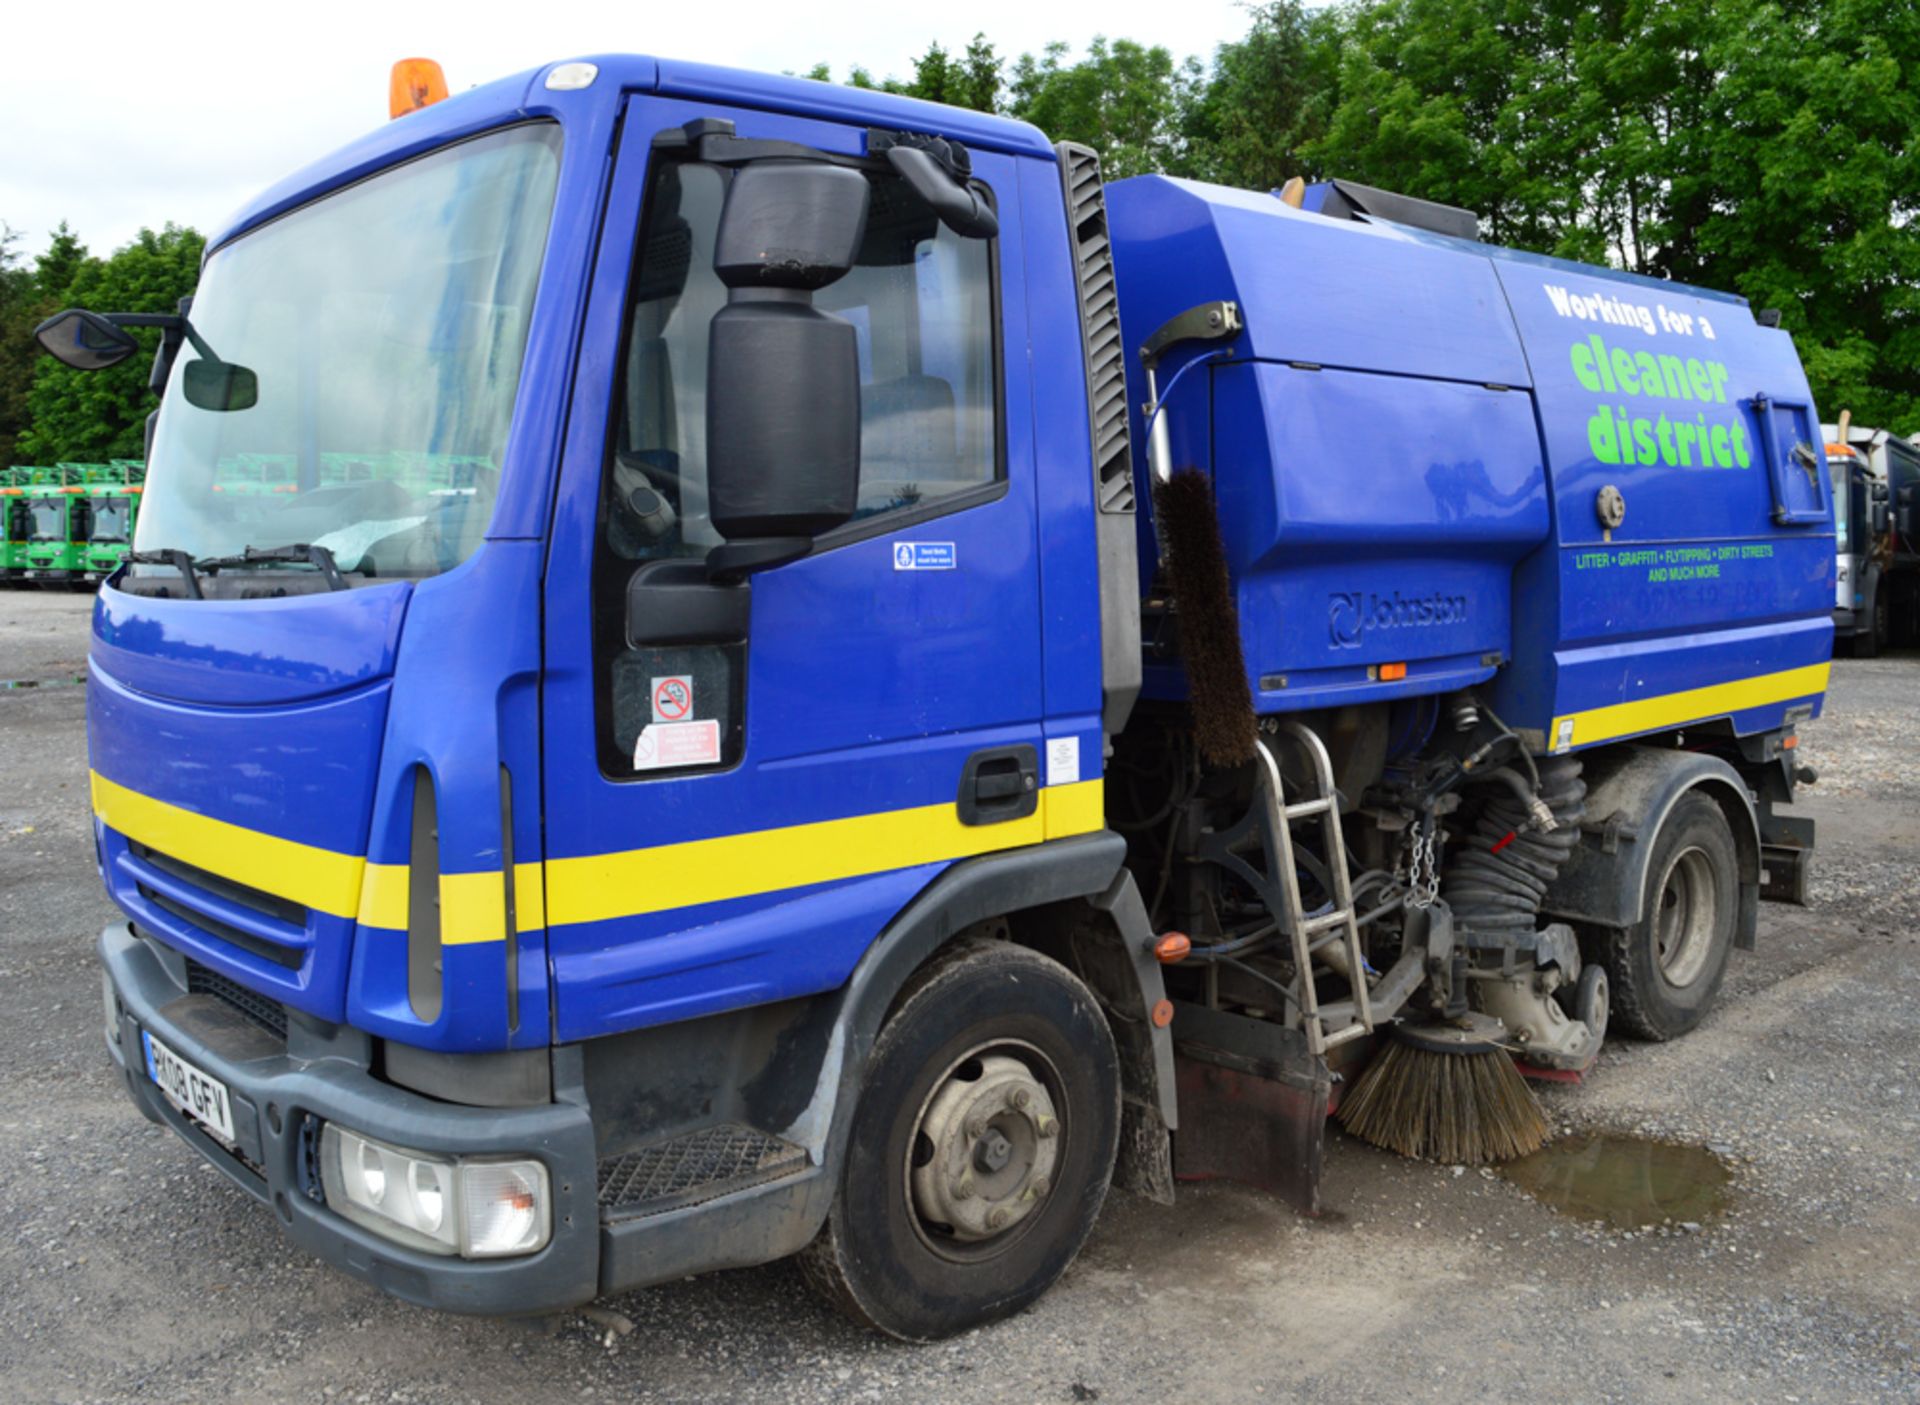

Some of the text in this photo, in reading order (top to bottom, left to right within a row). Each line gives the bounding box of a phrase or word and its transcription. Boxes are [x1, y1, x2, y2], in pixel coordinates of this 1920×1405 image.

[1543, 284, 1716, 340] Working for a
[1570, 333, 1729, 404] cleaner
[1587, 404, 1750, 469] district
[1575, 544, 1774, 569] LITTER GRAFFITI FLYTIPPING DIRTY STREETS
[1648, 564, 1720, 583] AND MUCH MORE
[1365, 591, 1467, 631] Johnston
